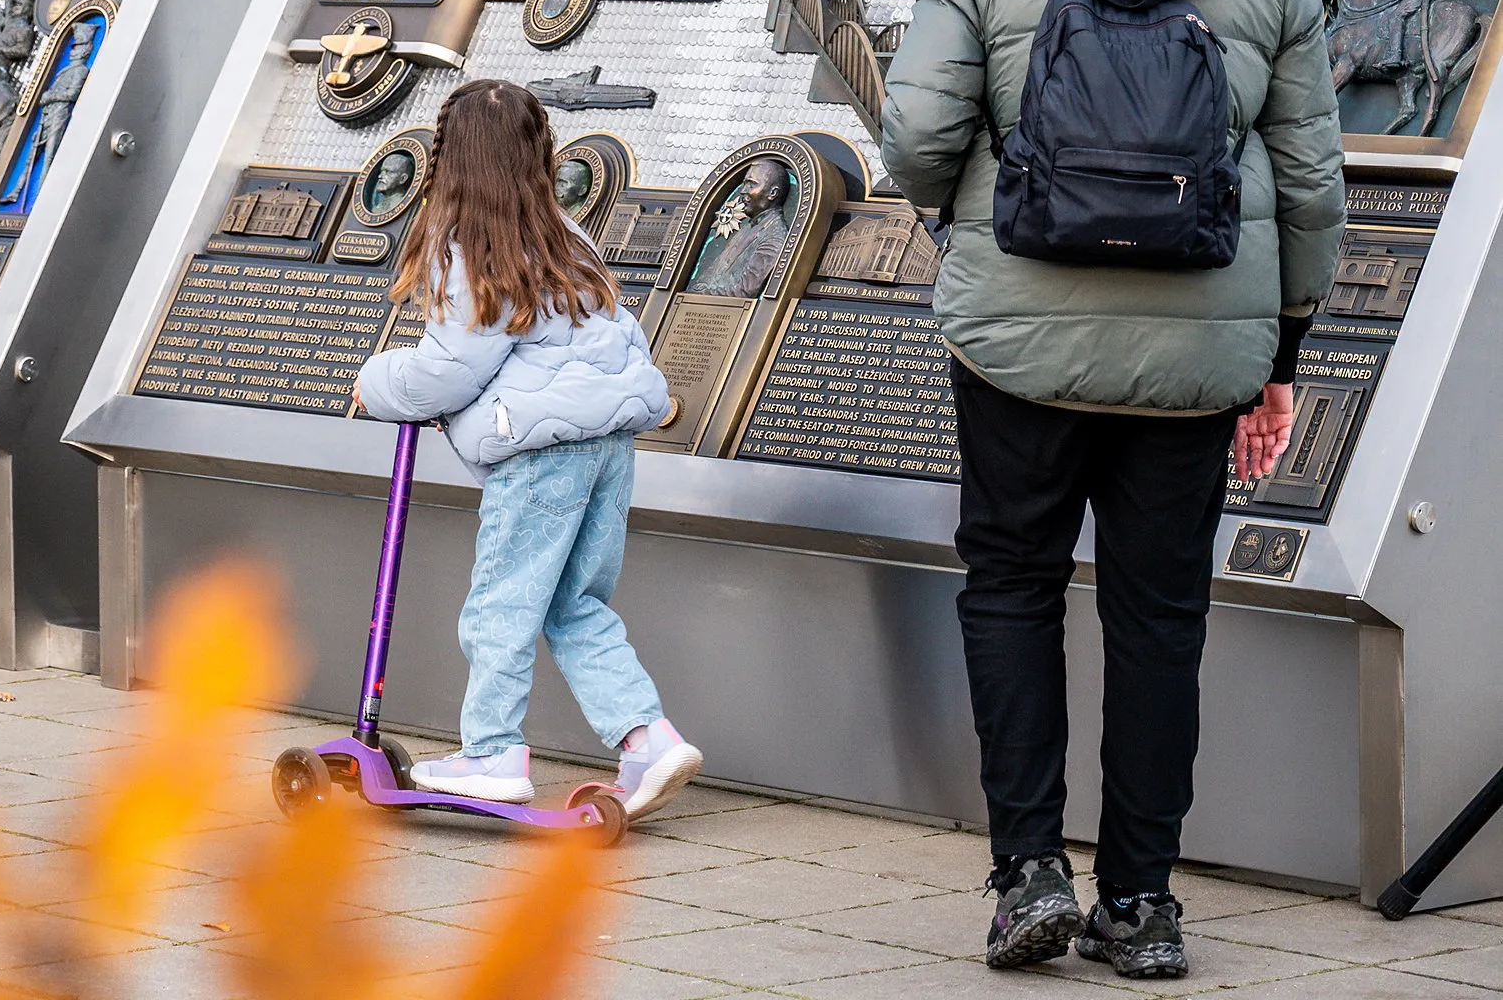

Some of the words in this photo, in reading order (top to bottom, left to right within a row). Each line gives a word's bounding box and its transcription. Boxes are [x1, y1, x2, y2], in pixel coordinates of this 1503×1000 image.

[1348, 189, 1404, 200] LIETUVOS
[665, 238, 683, 271] JONAS
[714, 147, 752, 177] KAUNO
[757, 142, 794, 154] MIESTO
[795, 151, 812, 219] BURMISTRAS
[1346, 200, 1403, 212] RADVILOS
[337, 246, 379, 255] STULGINSKIS
[338, 235, 385, 246] ALEKSANDRAS
[190, 263, 208, 272] 1919
[211, 264, 239, 274] METAIS
[284, 270, 329, 281] GRASINANT
[333, 274, 362, 284] VILNIUI
[365, 276, 388, 286] BUVO
[819, 285, 858, 296] LIETUVOS
[861, 288, 889, 298] BANKO
[893, 289, 921, 300] RŪMAI
[177, 292, 215, 303] LIETUVOS
[302, 302, 346, 314] PREMJERO
[347, 306, 383, 317] MYKOLO
[796, 308, 806, 317] IN
[809, 309, 827, 320] 1919,
[831, 311, 856, 321] WHEN
[858, 314, 890, 324] VILNIUS
[892, 316, 911, 326] WAS
[791, 322, 809, 331] WAS
[810, 324, 817, 332] A
[820, 325, 868, 336] DISCUSSION
[869, 329, 899, 339] ABOUT
[901, 331, 930, 342] WHERE
[932, 334, 945, 343] TO
[785, 335, 797, 344] OF
[799, 336, 815, 346] THE
[816, 338, 865, 350] LITHUANIAN
[866, 342, 891, 353] STATE,
[895, 345, 923, 355] WHICH
[924, 347, 943, 357] HAD
[151, 350, 185, 361] ANTANAS
[186, 353, 222, 366] SMETONA,
[225, 357, 278, 370] ALEKSANDRAS
[280, 363, 328, 376] STULGINSKIS,
[331, 368, 358, 378] KAZYS
[781, 348, 801, 358] YEAR
[802, 351, 835, 361] EARLIER.
[839, 354, 865, 364] BASED
[867, 356, 881, 365] ON
[882, 358, 889, 366] A
[891, 359, 930, 370] DECISION
[932, 362, 945, 371] OF
[1327, 351, 1378, 365] EUROPEAN
[774, 362, 811, 373] MINISTER
[813, 365, 852, 377] MYKOLAS
[854, 369, 904, 383] SLEŽEVIČIUS,
[909, 374, 926, 384] THE
[181, 383, 191, 393] IR
[192, 385, 216, 395] KITOS
[271, 393, 324, 407] INSTITUCIJOS.
[328, 399, 345, 409] PER
[770, 375, 823, 388] TEMPORARILY
[827, 381, 857, 391] MOVED
[862, 384, 873, 393] TO
[878, 386, 912, 397] KAUNAS
[916, 389, 941, 399] FROM
[764, 389, 797, 399] TWENTY
[799, 392, 824, 403] YEARS,
[827, 395, 837, 404] IT
[838, 396, 857, 406] WAS
[859, 398, 875, 407] THE
[876, 400, 921, 412] RESIDENCE
[922, 404, 935, 413] OF
[758, 402, 797, 415] SMETONA,
[801, 407, 858, 420] ALEKSANDRAS
[861, 412, 913, 425] STULGINSKIS
[916, 418, 935, 428] AND
[753, 415, 773, 425] WELL
[773, 417, 786, 427] AS
[786, 419, 802, 428] THE
[801, 420, 822, 430] SEAT
[822, 422, 834, 431] OF
[835, 423, 851, 433] THE
[850, 425, 881, 436] SEIMAS
[881, 429, 937, 443] (PARLIAMENT),
[940, 434, 957, 444] THE
[748, 429, 764, 438] THE
[764, 431, 806, 443] COMMAND
[806, 435, 818, 444] OF
[818, 437, 847, 447] ARMED
[848, 439, 879, 450] FORCES
[878, 443, 898, 452] AND
[898, 445, 926, 455] OTHER
[926, 448, 951, 458] STATE
[742, 442, 752, 451] IN
[753, 444, 760, 452] A
[762, 445, 790, 455] SHORT
[791, 448, 821, 459] PERIOD
[824, 451, 836, 460] OF
[839, 452, 859, 464] TIME,
[863, 455, 897, 467] KAUNAS
[899, 459, 924, 470] GREW
[926, 462, 951, 473] FROM
[953, 465, 960, 474] A
[1244, 481, 1256, 491] IN
[1225, 494, 1249, 506] 1940.
